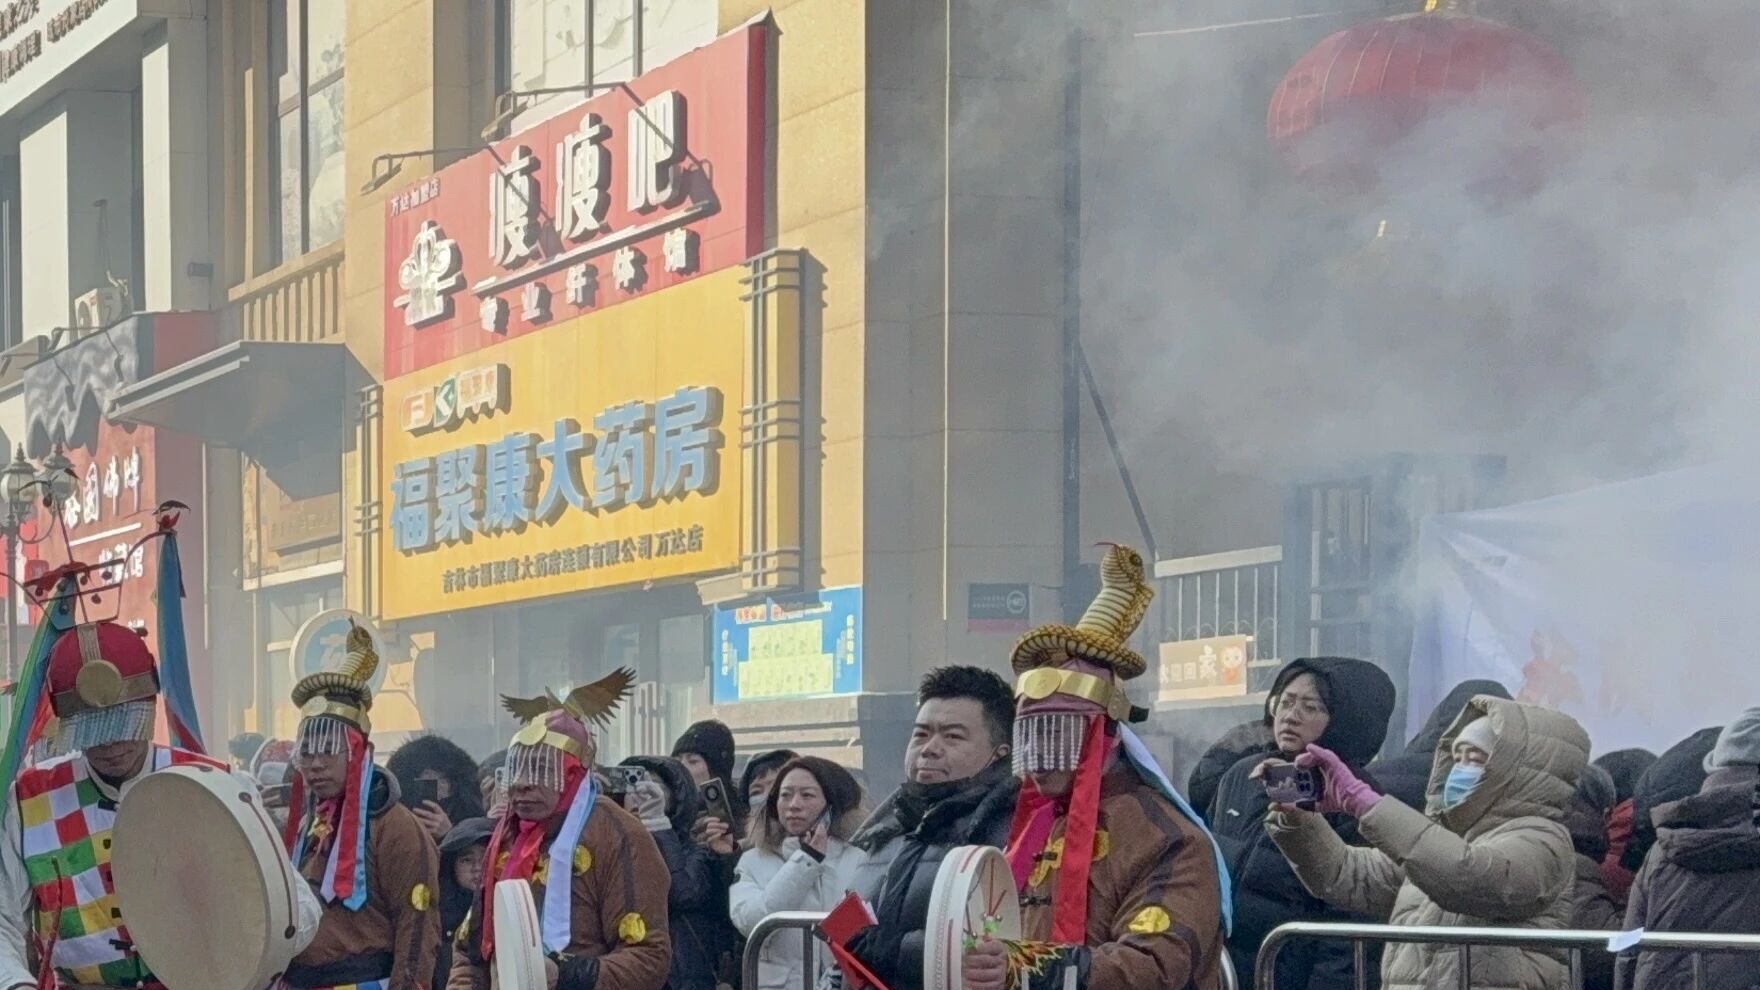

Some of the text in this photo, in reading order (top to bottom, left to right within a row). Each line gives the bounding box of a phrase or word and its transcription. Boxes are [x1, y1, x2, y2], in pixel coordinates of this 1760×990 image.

[489, 89, 675, 270] 瘦瘦吧
[390, 385, 714, 552] 福聚康大药房
[654, 523, 705, 558] 万达店
